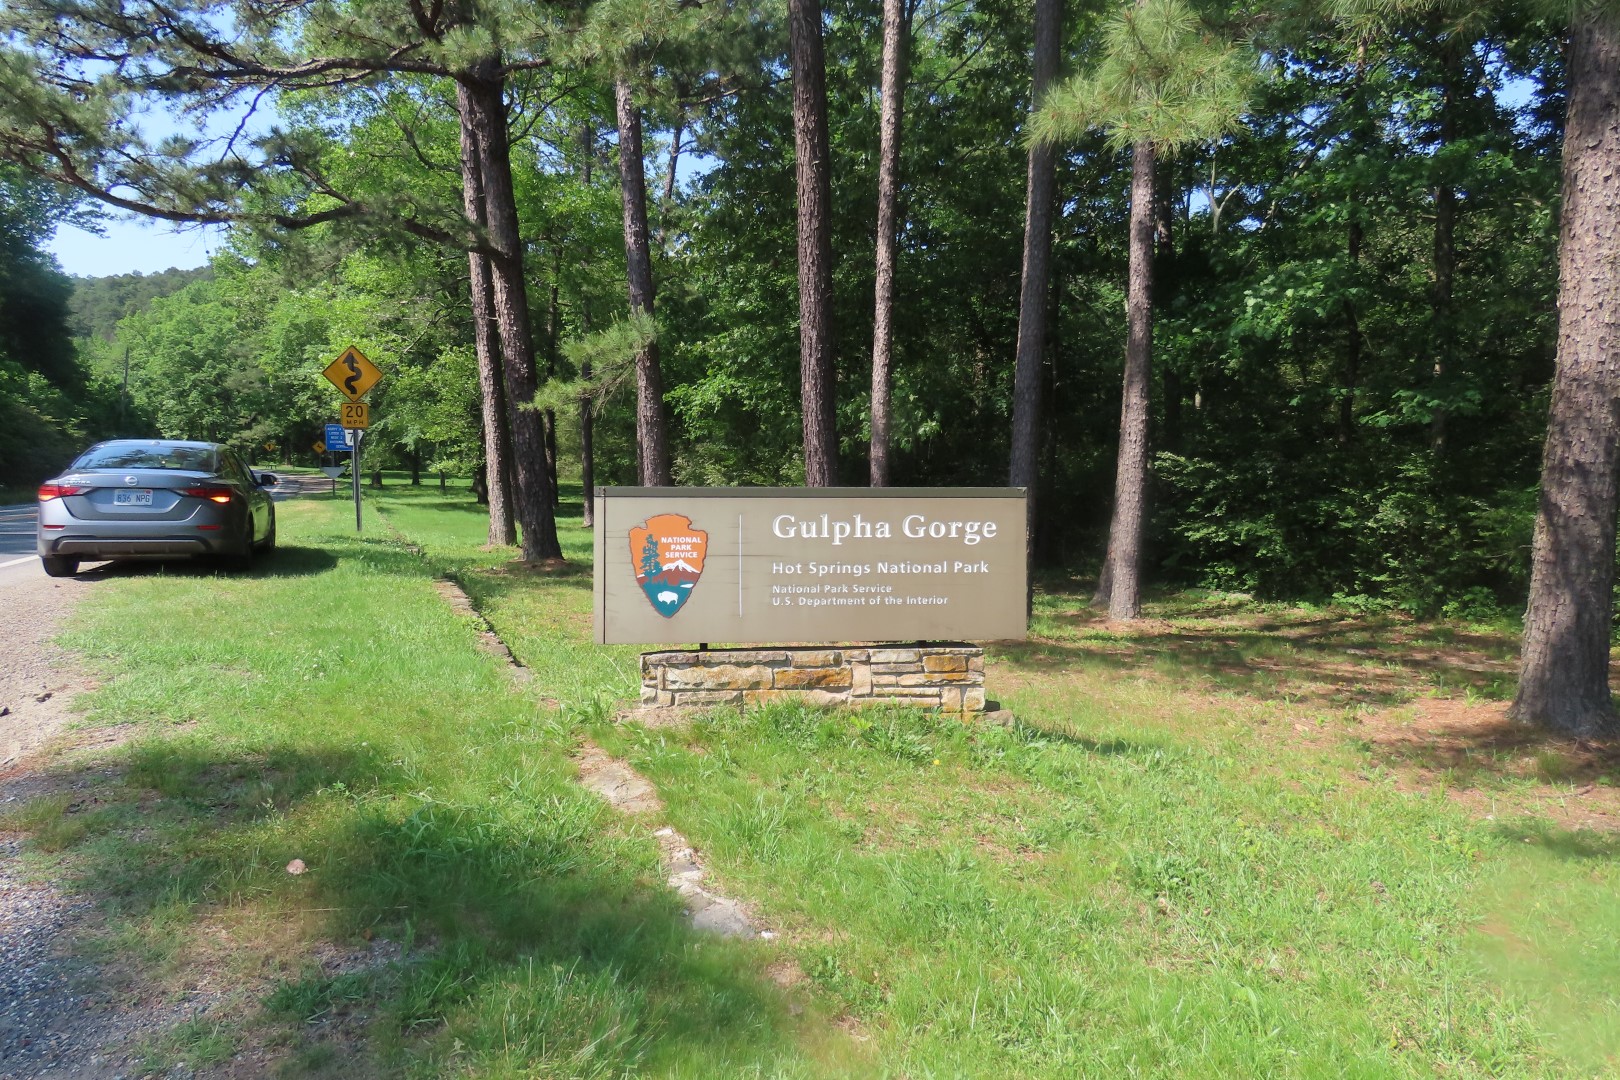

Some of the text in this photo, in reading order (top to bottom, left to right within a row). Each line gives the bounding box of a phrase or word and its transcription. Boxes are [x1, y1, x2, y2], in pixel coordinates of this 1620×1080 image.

[345, 405, 364, 418] 20
[772, 513, 997, 546] Gulpha Gorge
[661, 536, 702, 544] NATIONAL
[665, 551, 698, 559] SERVICE
[772, 560, 989, 577] Hot Springs National Park
[772, 584, 892, 594] National Park Service
[772, 595, 949, 608] U.S. Department of the Interior
